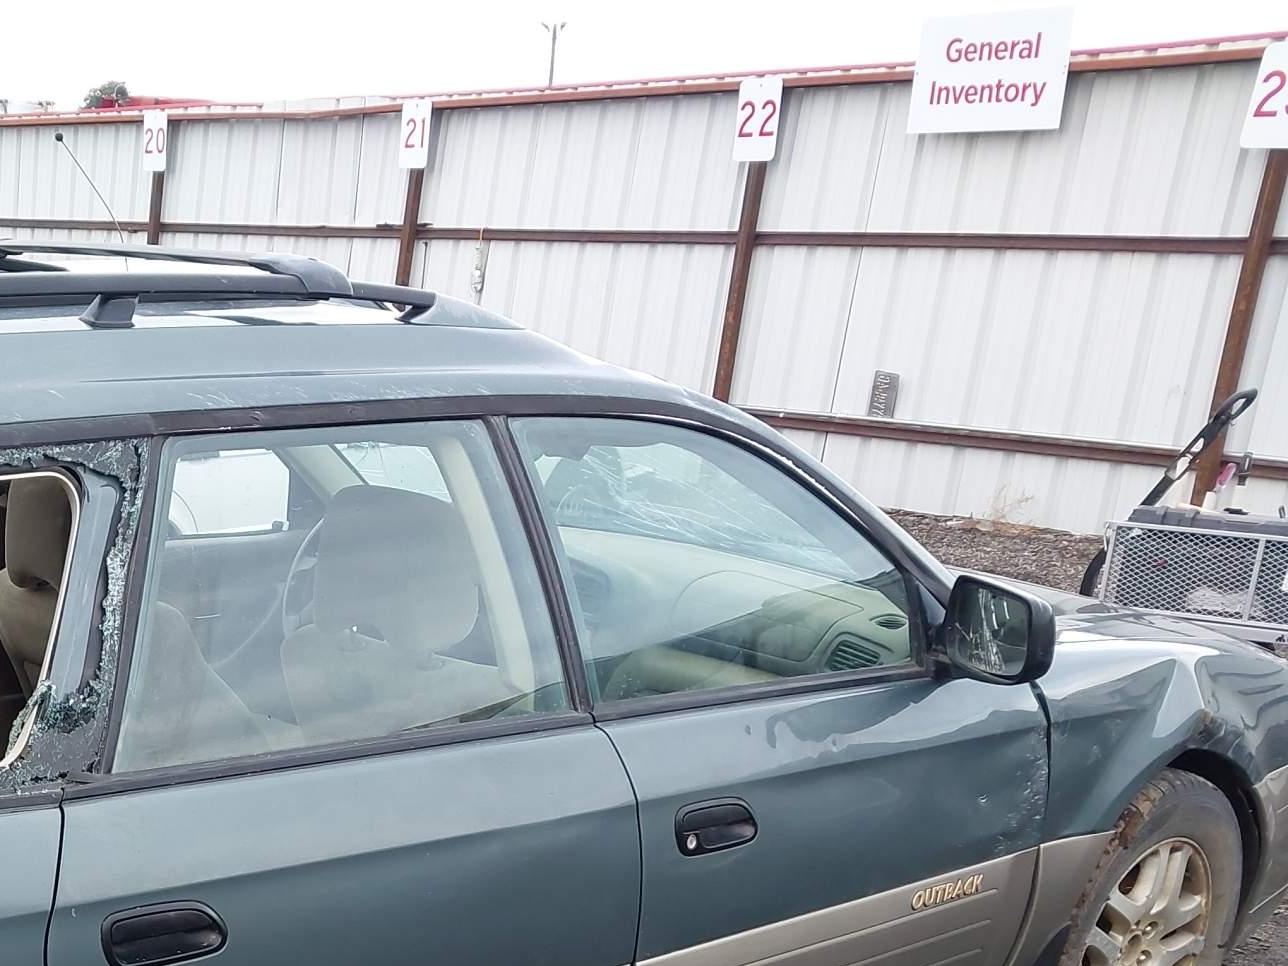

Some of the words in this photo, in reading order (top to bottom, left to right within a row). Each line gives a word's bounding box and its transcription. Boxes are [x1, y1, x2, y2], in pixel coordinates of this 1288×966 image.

[946, 32, 1042, 63] General
[929, 79, 1047, 107] Inventory
[1253, 69, 1288, 117] 2
[405, 116, 425, 148] 21
[738, 99, 776, 137] 22
[145, 127, 165, 154] 20
[911, 873, 984, 911] OUTBACK
